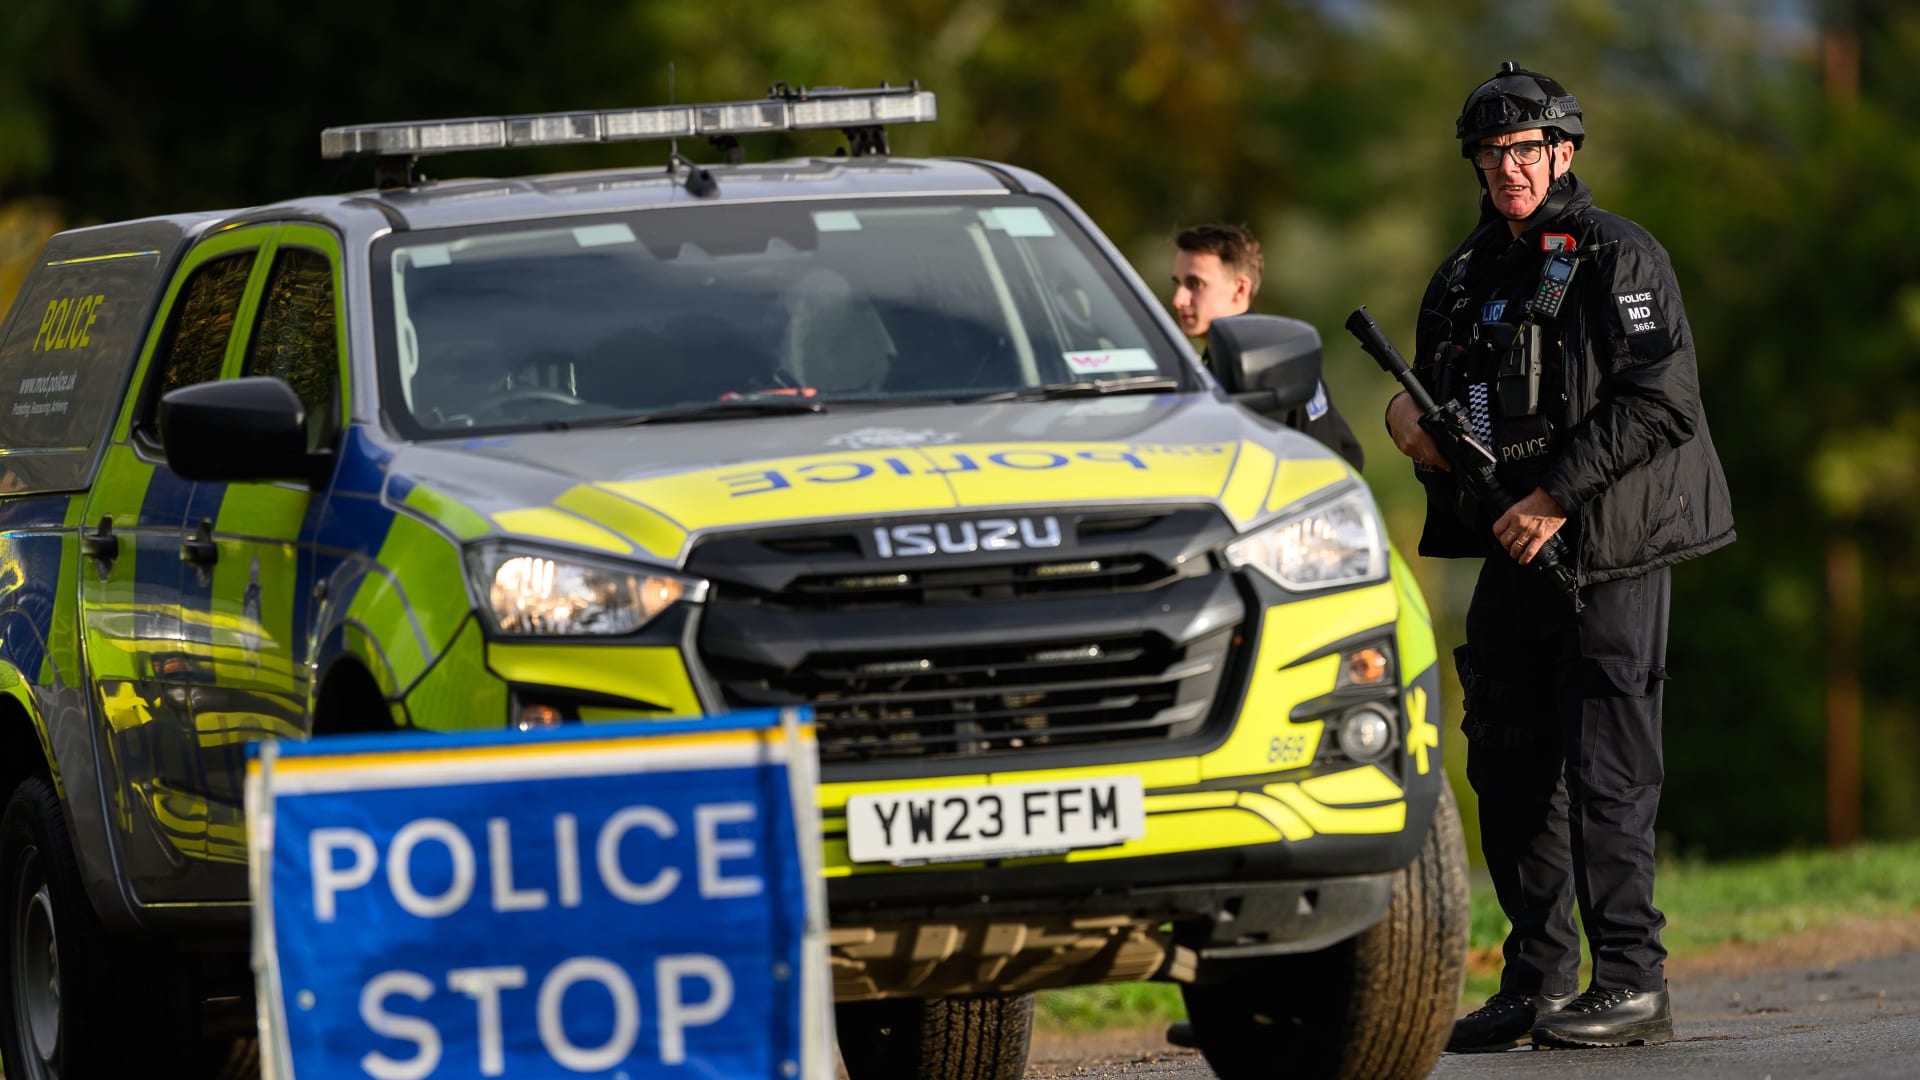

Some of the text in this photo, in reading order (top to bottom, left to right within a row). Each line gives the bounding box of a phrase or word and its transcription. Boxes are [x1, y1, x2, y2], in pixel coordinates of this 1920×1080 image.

[1619, 292, 1653, 304] POLICE
[1628, 306, 1651, 320] MD
[32, 295, 104, 352] POLICE
[1633, 321, 1656, 332] 3662
[1502, 437, 1549, 462] POLICE
[872, 515, 1062, 559] ISUZU
[1268, 735, 1304, 764] 869
[873, 784, 1119, 847] YW23 FFM
[309, 803, 765, 923] POLICE
[358, 953, 735, 1080] STOP
